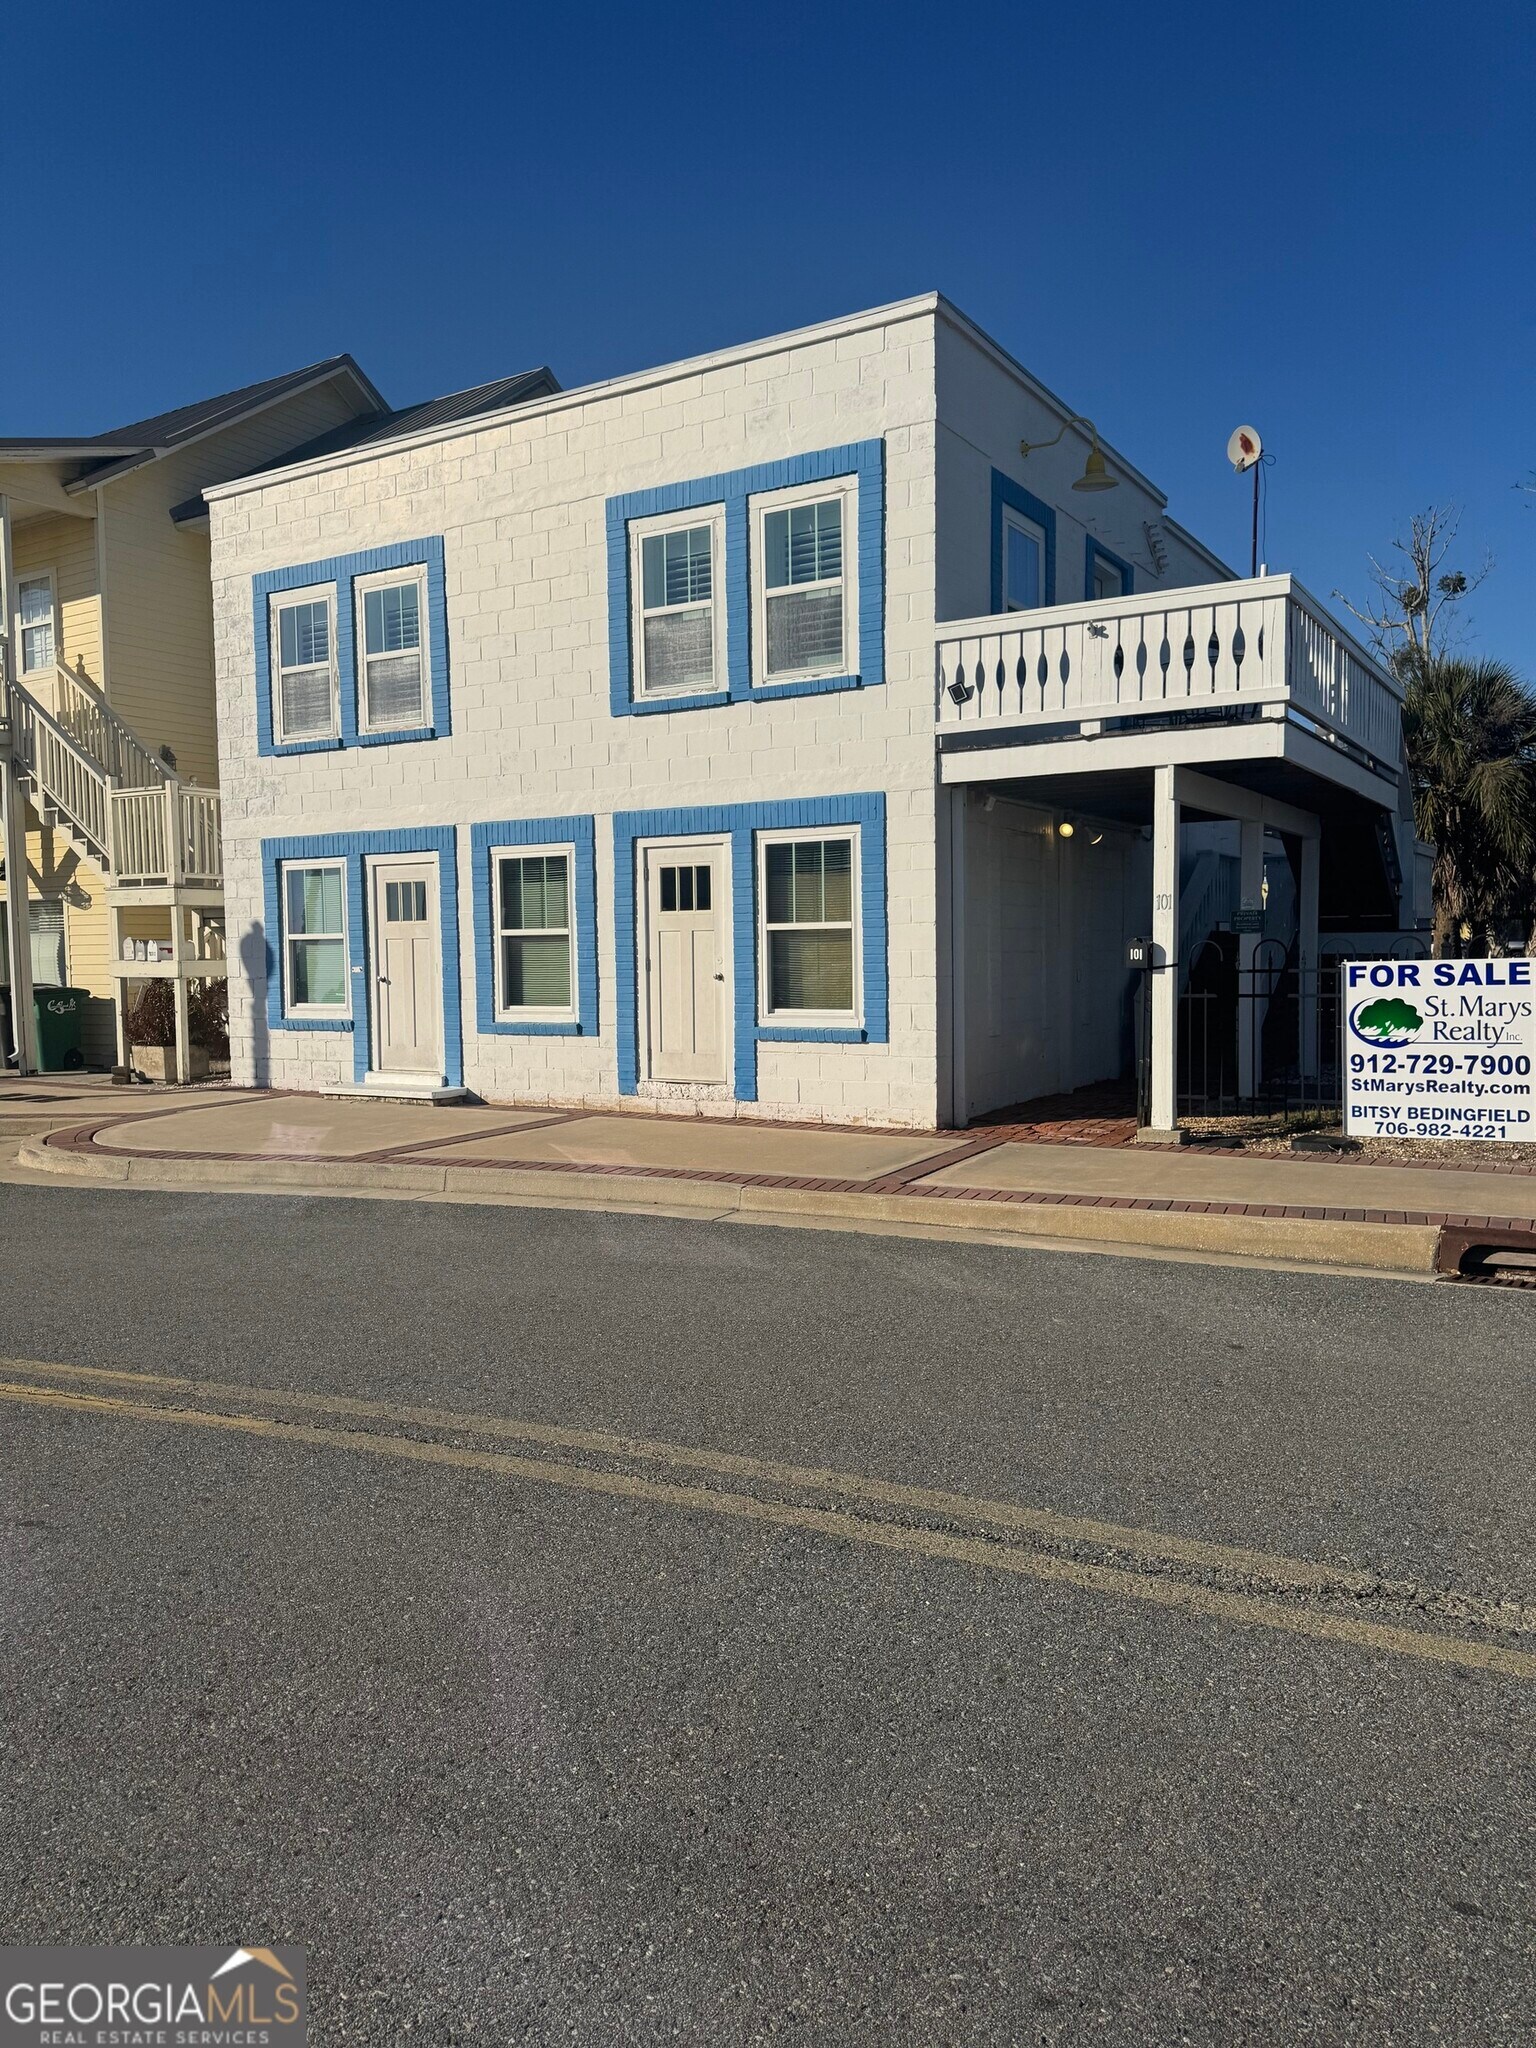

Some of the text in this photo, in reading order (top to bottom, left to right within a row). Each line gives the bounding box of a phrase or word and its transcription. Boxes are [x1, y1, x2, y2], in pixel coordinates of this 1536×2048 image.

[1156, 893, 1172, 911] 101
[1130, 948, 1143, 960] 101
[1349, 962, 1531, 987] FOR SALE
[1424, 995, 1532, 1025] St. Marys
[1433, 1020, 1523, 1048] Realty Inc.
[1350, 1054, 1531, 1076] 912-729-7900
[1351, 1079, 1531, 1097] StMarysRealty.com
[1351, 1105, 1531, 1123] BITSY BEDINGFIELD
[1374, 1122, 1506, 1139] 706-982-4221
